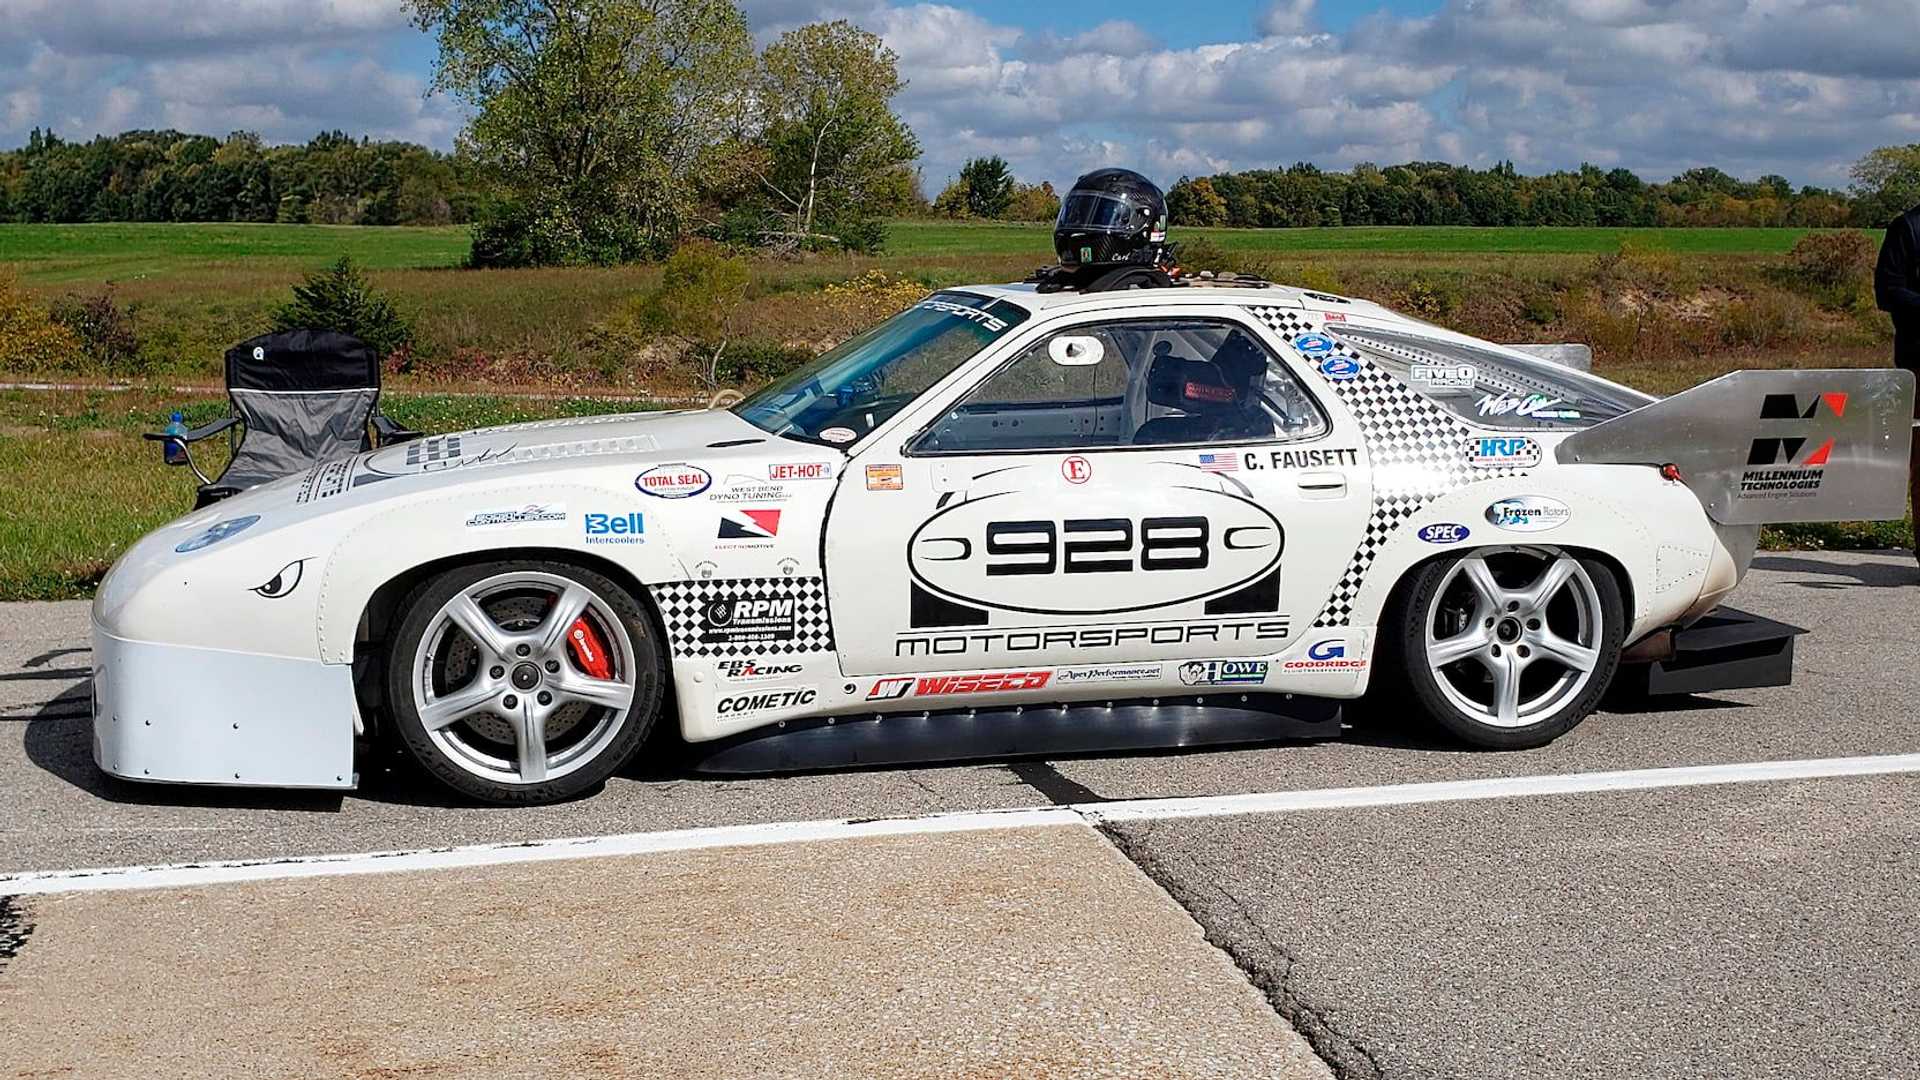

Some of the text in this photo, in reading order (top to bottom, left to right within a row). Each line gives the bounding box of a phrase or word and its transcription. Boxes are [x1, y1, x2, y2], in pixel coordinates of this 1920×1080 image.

[1480, 438, 1527, 456] HRP
[1244, 448, 1357, 470] C. FAUSETT
[771, 464, 822, 479] JET-HOT
[1070, 460, 1085, 480] E
[1742, 469, 1824, 481] MILLENNIUM
[643, 473, 705, 487] TOTAL SEAL
[1740, 480, 1820, 490] TECHNOLOGIES
[741, 492, 781, 500] TUNING
[1767, 491, 1787, 500] Engine
[1788, 490, 1817, 498] Solutions
[1503, 505, 1569, 516] Frozen Rotors
[586, 512, 644, 534] Bell
[1426, 525, 1461, 540] SPEC
[585, 536, 645, 544] Intercoolers
[985, 515, 1210, 577] 928
[733, 599, 794, 618] RPM
[733, 616, 792, 625] Transmissions
[895, 620, 1290, 657] MOTORSPORTS
[718, 659, 757, 669] EBS
[726, 664, 803, 678] RACING
[1284, 660, 1367, 668] GOODRIDGE
[1200, 662, 1267, 681] HOWE
[717, 689, 817, 713] COMETIC
